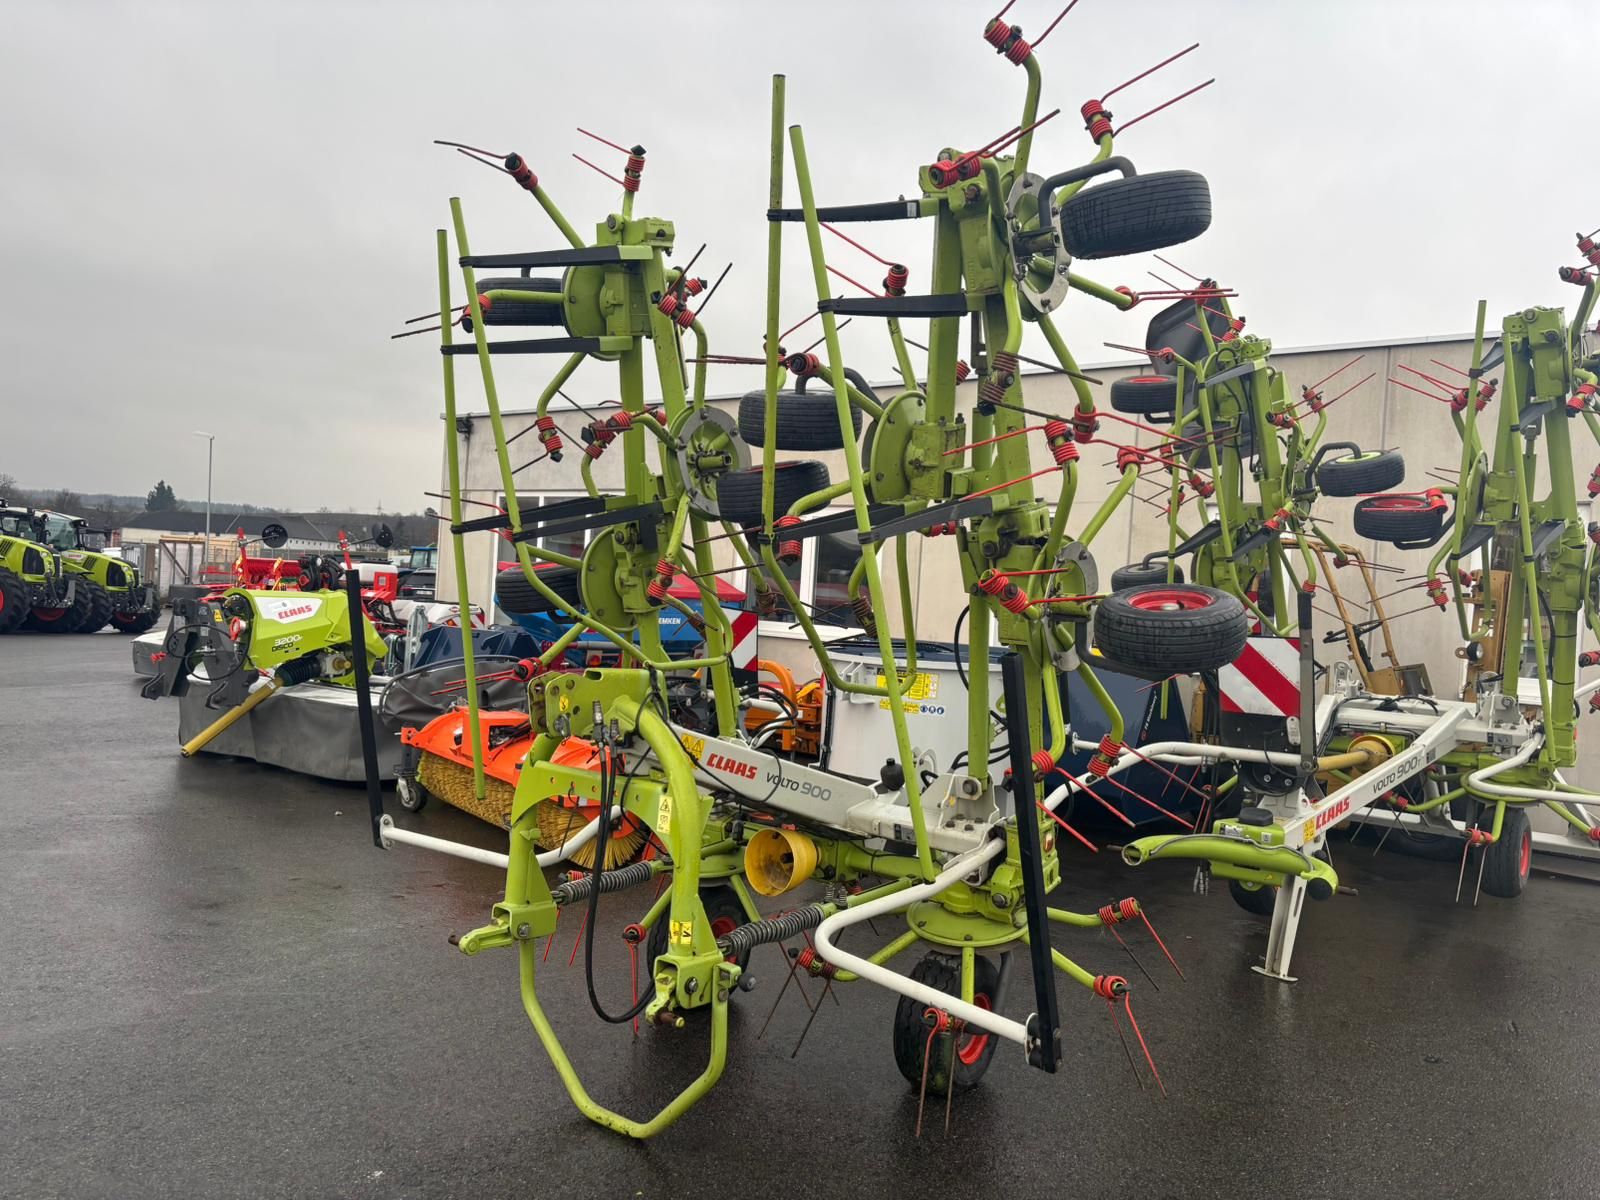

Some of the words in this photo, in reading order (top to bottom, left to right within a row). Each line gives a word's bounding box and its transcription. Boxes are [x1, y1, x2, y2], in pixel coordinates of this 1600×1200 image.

[278, 604, 313, 620] CLAAS
[271, 642, 294, 652] DISCO
[706, 753, 758, 780] CLAAS
[766, 772, 799, 791] VOLTO
[800, 782, 832, 801] 900
[1315, 796, 1351, 829] CLAAS
[1373, 772, 1396, 793] VOLTO
